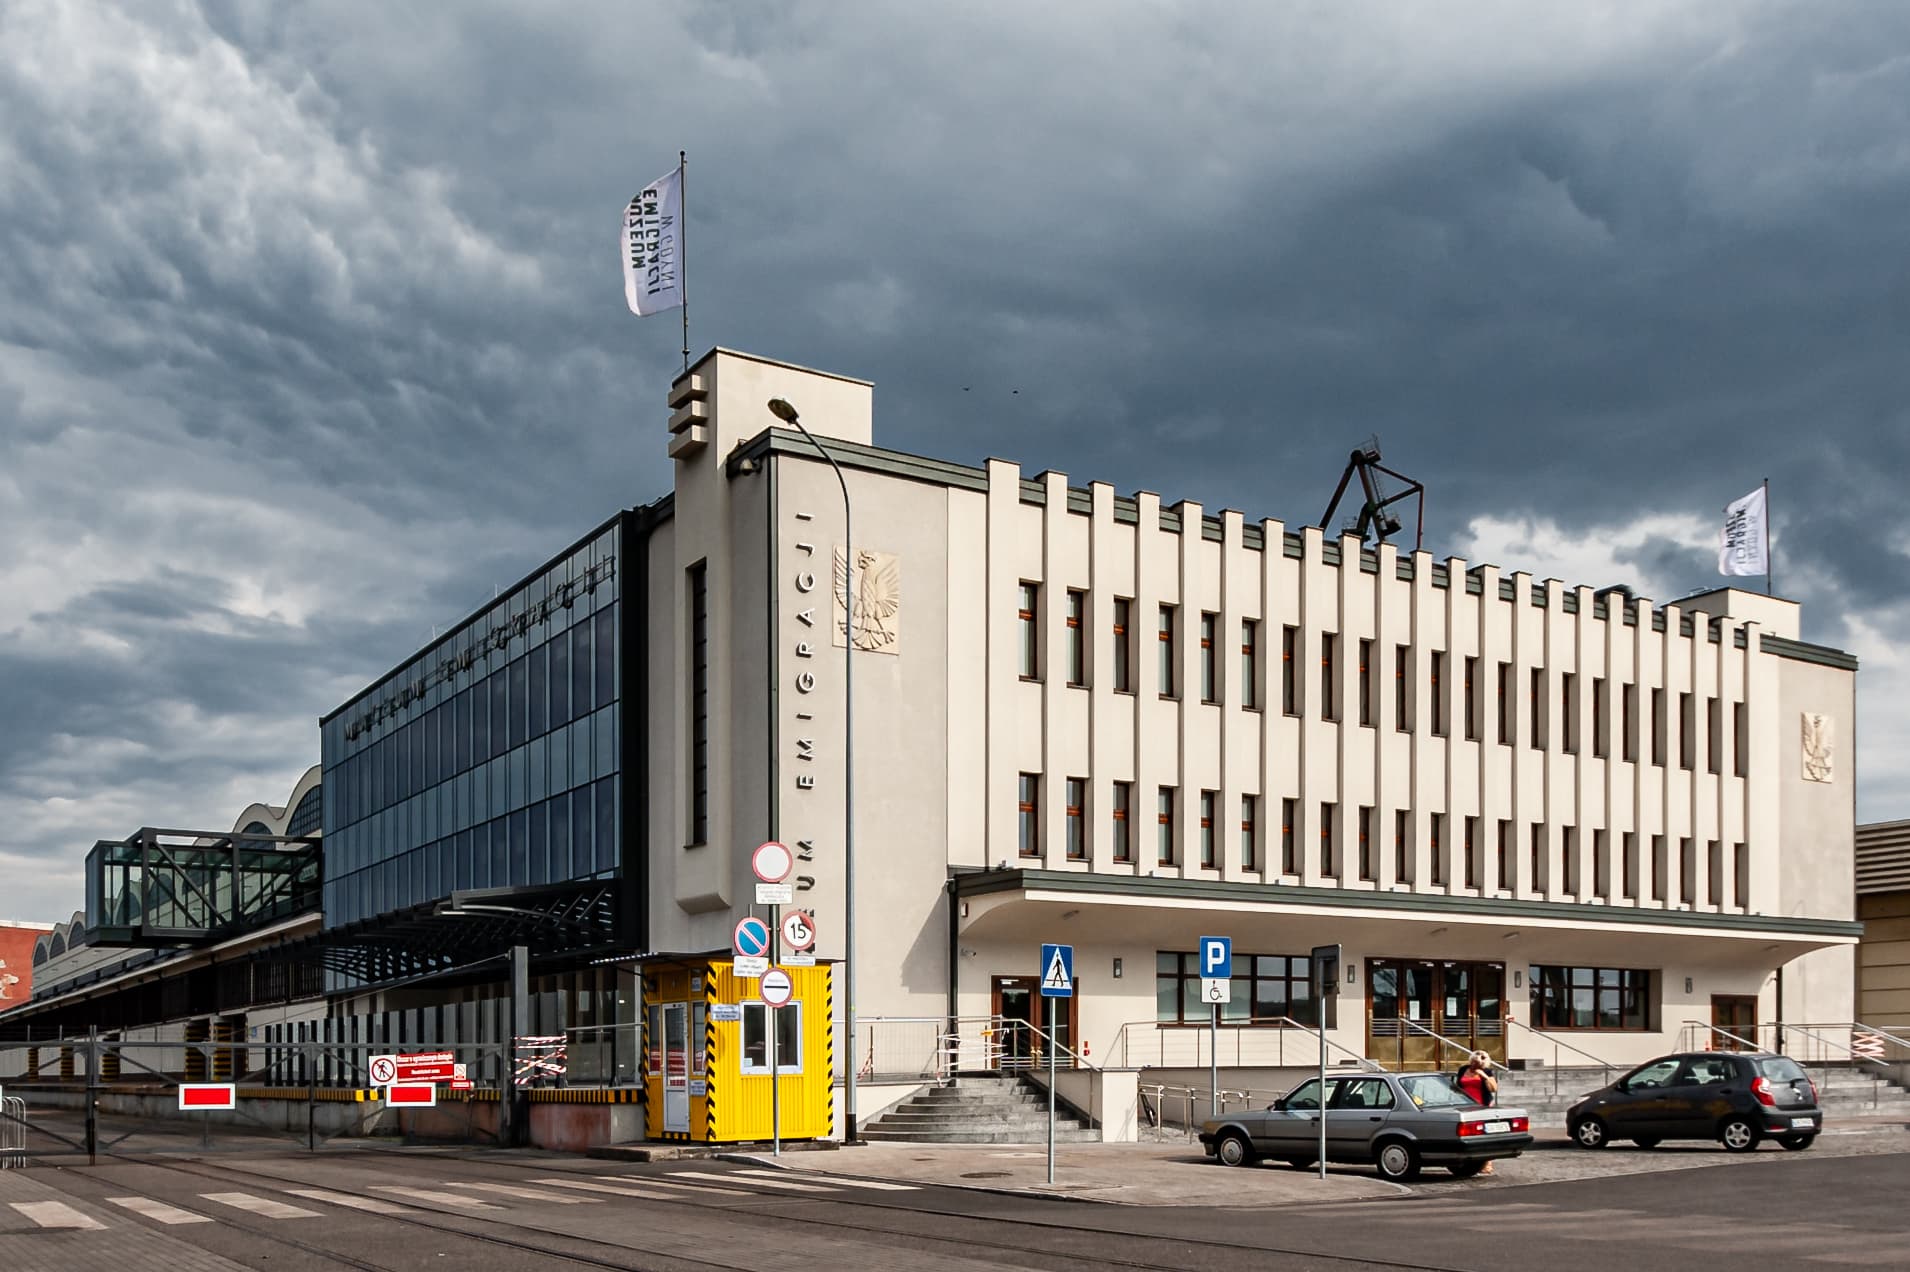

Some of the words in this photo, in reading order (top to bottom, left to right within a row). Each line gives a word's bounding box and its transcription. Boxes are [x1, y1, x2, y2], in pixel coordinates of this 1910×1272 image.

[795, 512, 816, 790] EMIGRACJI
[790, 922, 807, 940] 15
[1207, 941, 1225, 974] P
